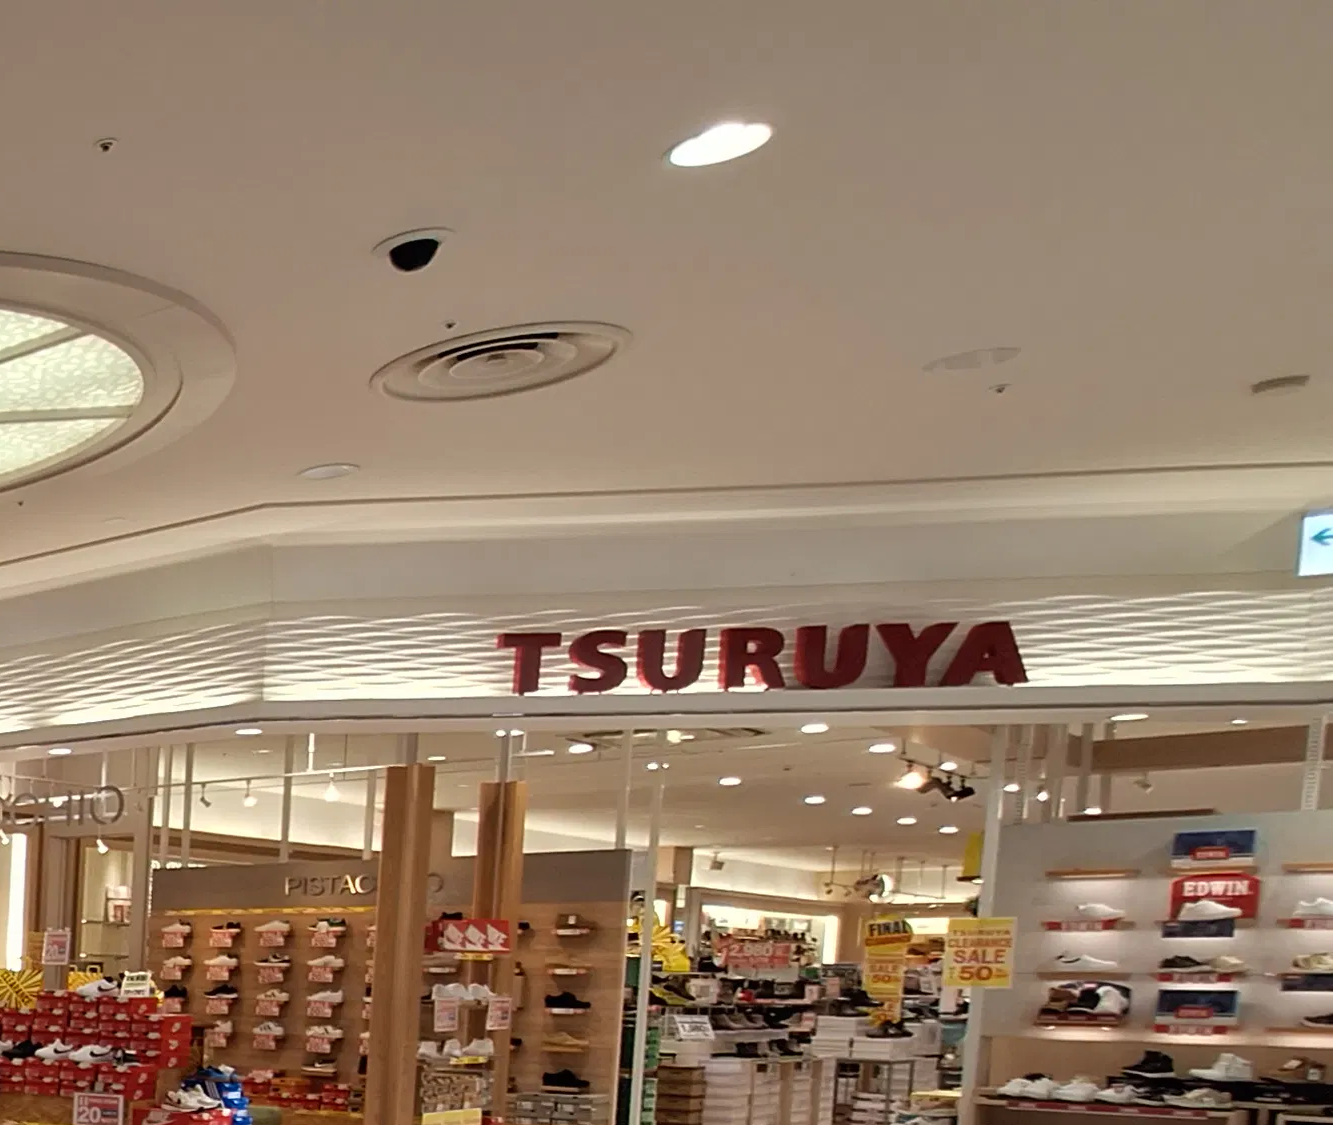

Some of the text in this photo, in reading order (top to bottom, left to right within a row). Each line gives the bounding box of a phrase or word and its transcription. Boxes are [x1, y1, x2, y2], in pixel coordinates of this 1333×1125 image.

[496, 620, 1029, 696] TSURUYA
[1183, 880, 1251, 897] EDWIN
[868, 920, 907, 937] FINAL
[947, 938, 1013, 948] CLEARANCE
[953, 949, 1006, 964] SALE
[77, 1106, 102, 1124] 20
